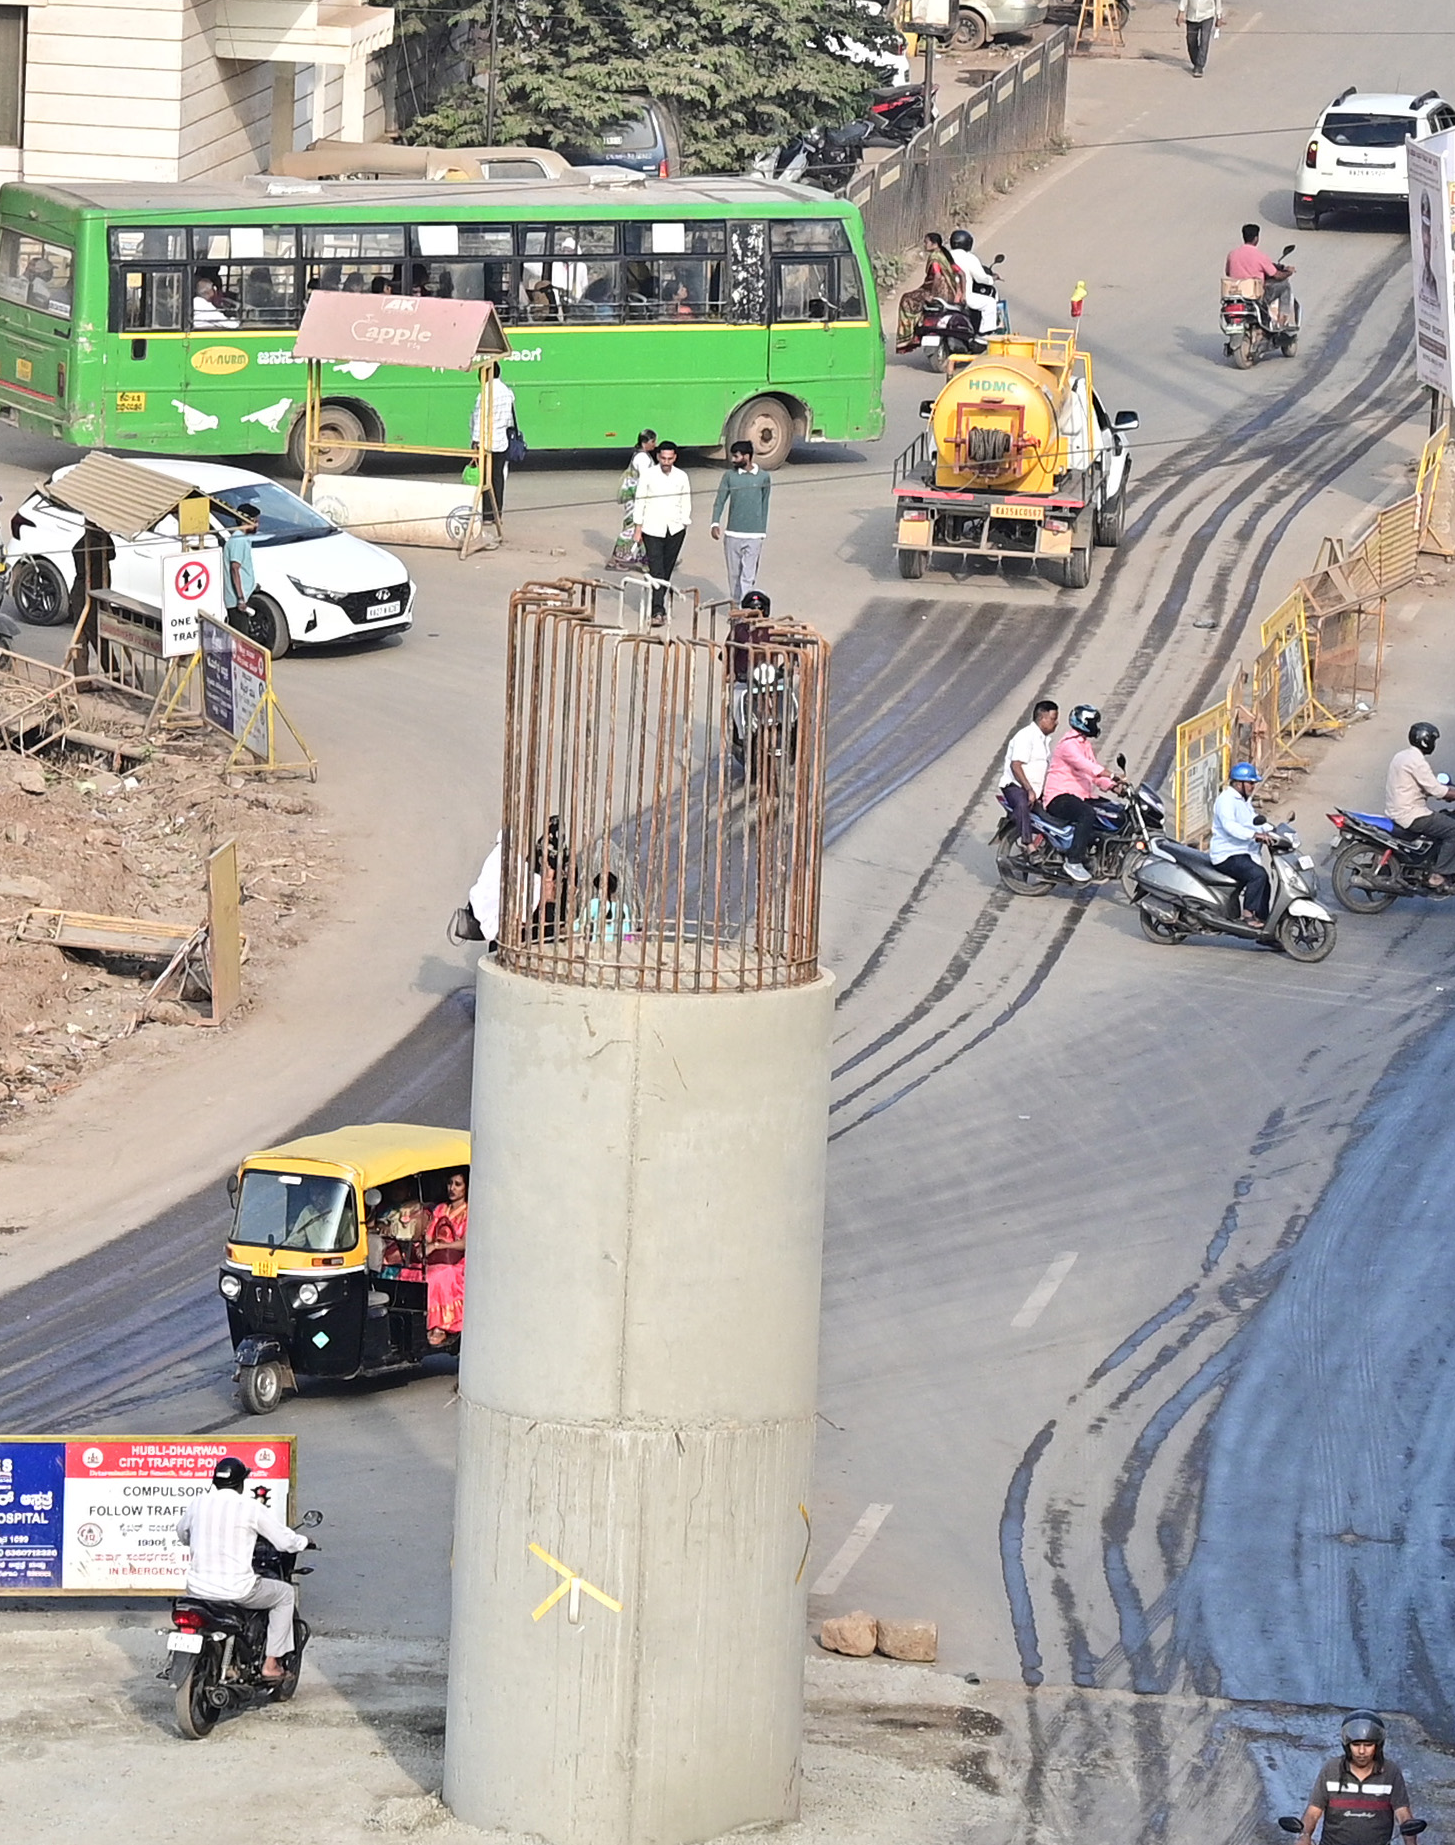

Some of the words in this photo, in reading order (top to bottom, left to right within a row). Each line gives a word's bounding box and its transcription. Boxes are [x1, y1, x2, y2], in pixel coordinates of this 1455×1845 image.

[969, 379, 1017, 394] HDMC
[170, 617, 192, 628] ONE
[131, 1446, 227, 1456] HUBLI-DHARWAD
[119, 1458, 149, 1468] CITY
[152, 1458, 195, 1468] TRAFFIC
[123, 1486, 210, 1497] COMPULSORY
[90, 1506, 142, 1516] FOLLOW
[122, 1567, 187, 1576] EMERGENCY
